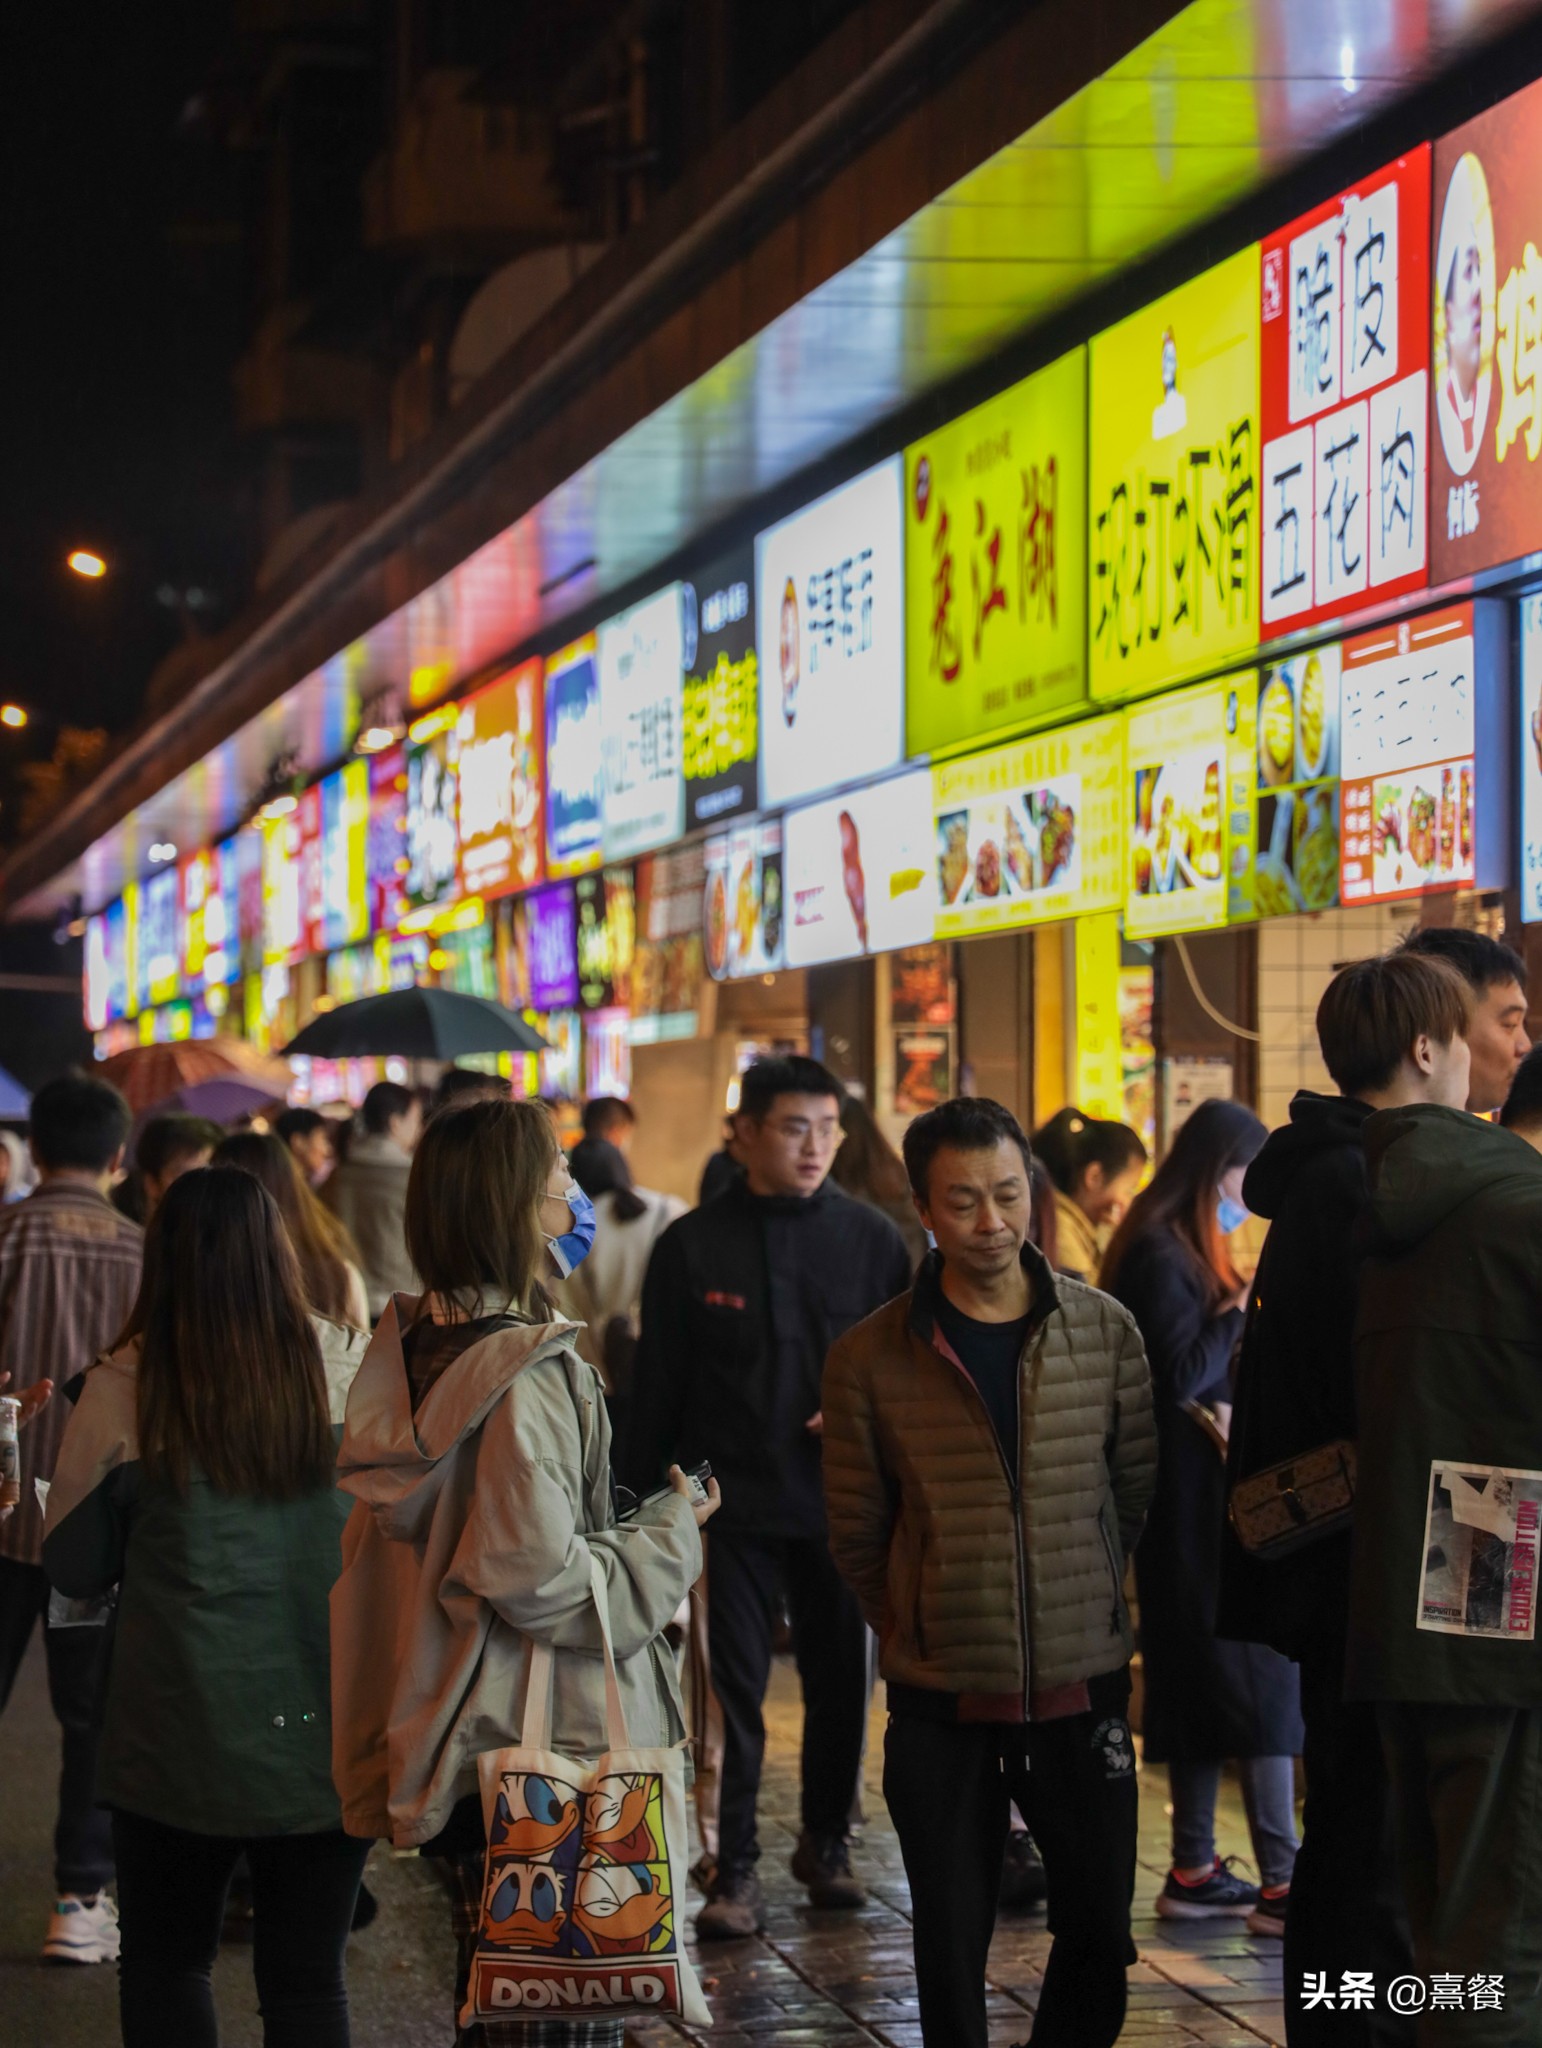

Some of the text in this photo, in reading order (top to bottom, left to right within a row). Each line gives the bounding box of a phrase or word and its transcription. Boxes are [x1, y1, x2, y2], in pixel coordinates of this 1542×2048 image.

[1295, 214, 1388, 398] 脆皮
[1096, 418, 1253, 660] 现打虾滑
[1269, 406, 1417, 600] 五花肉
[489, 1974, 666, 2009] DONALD
